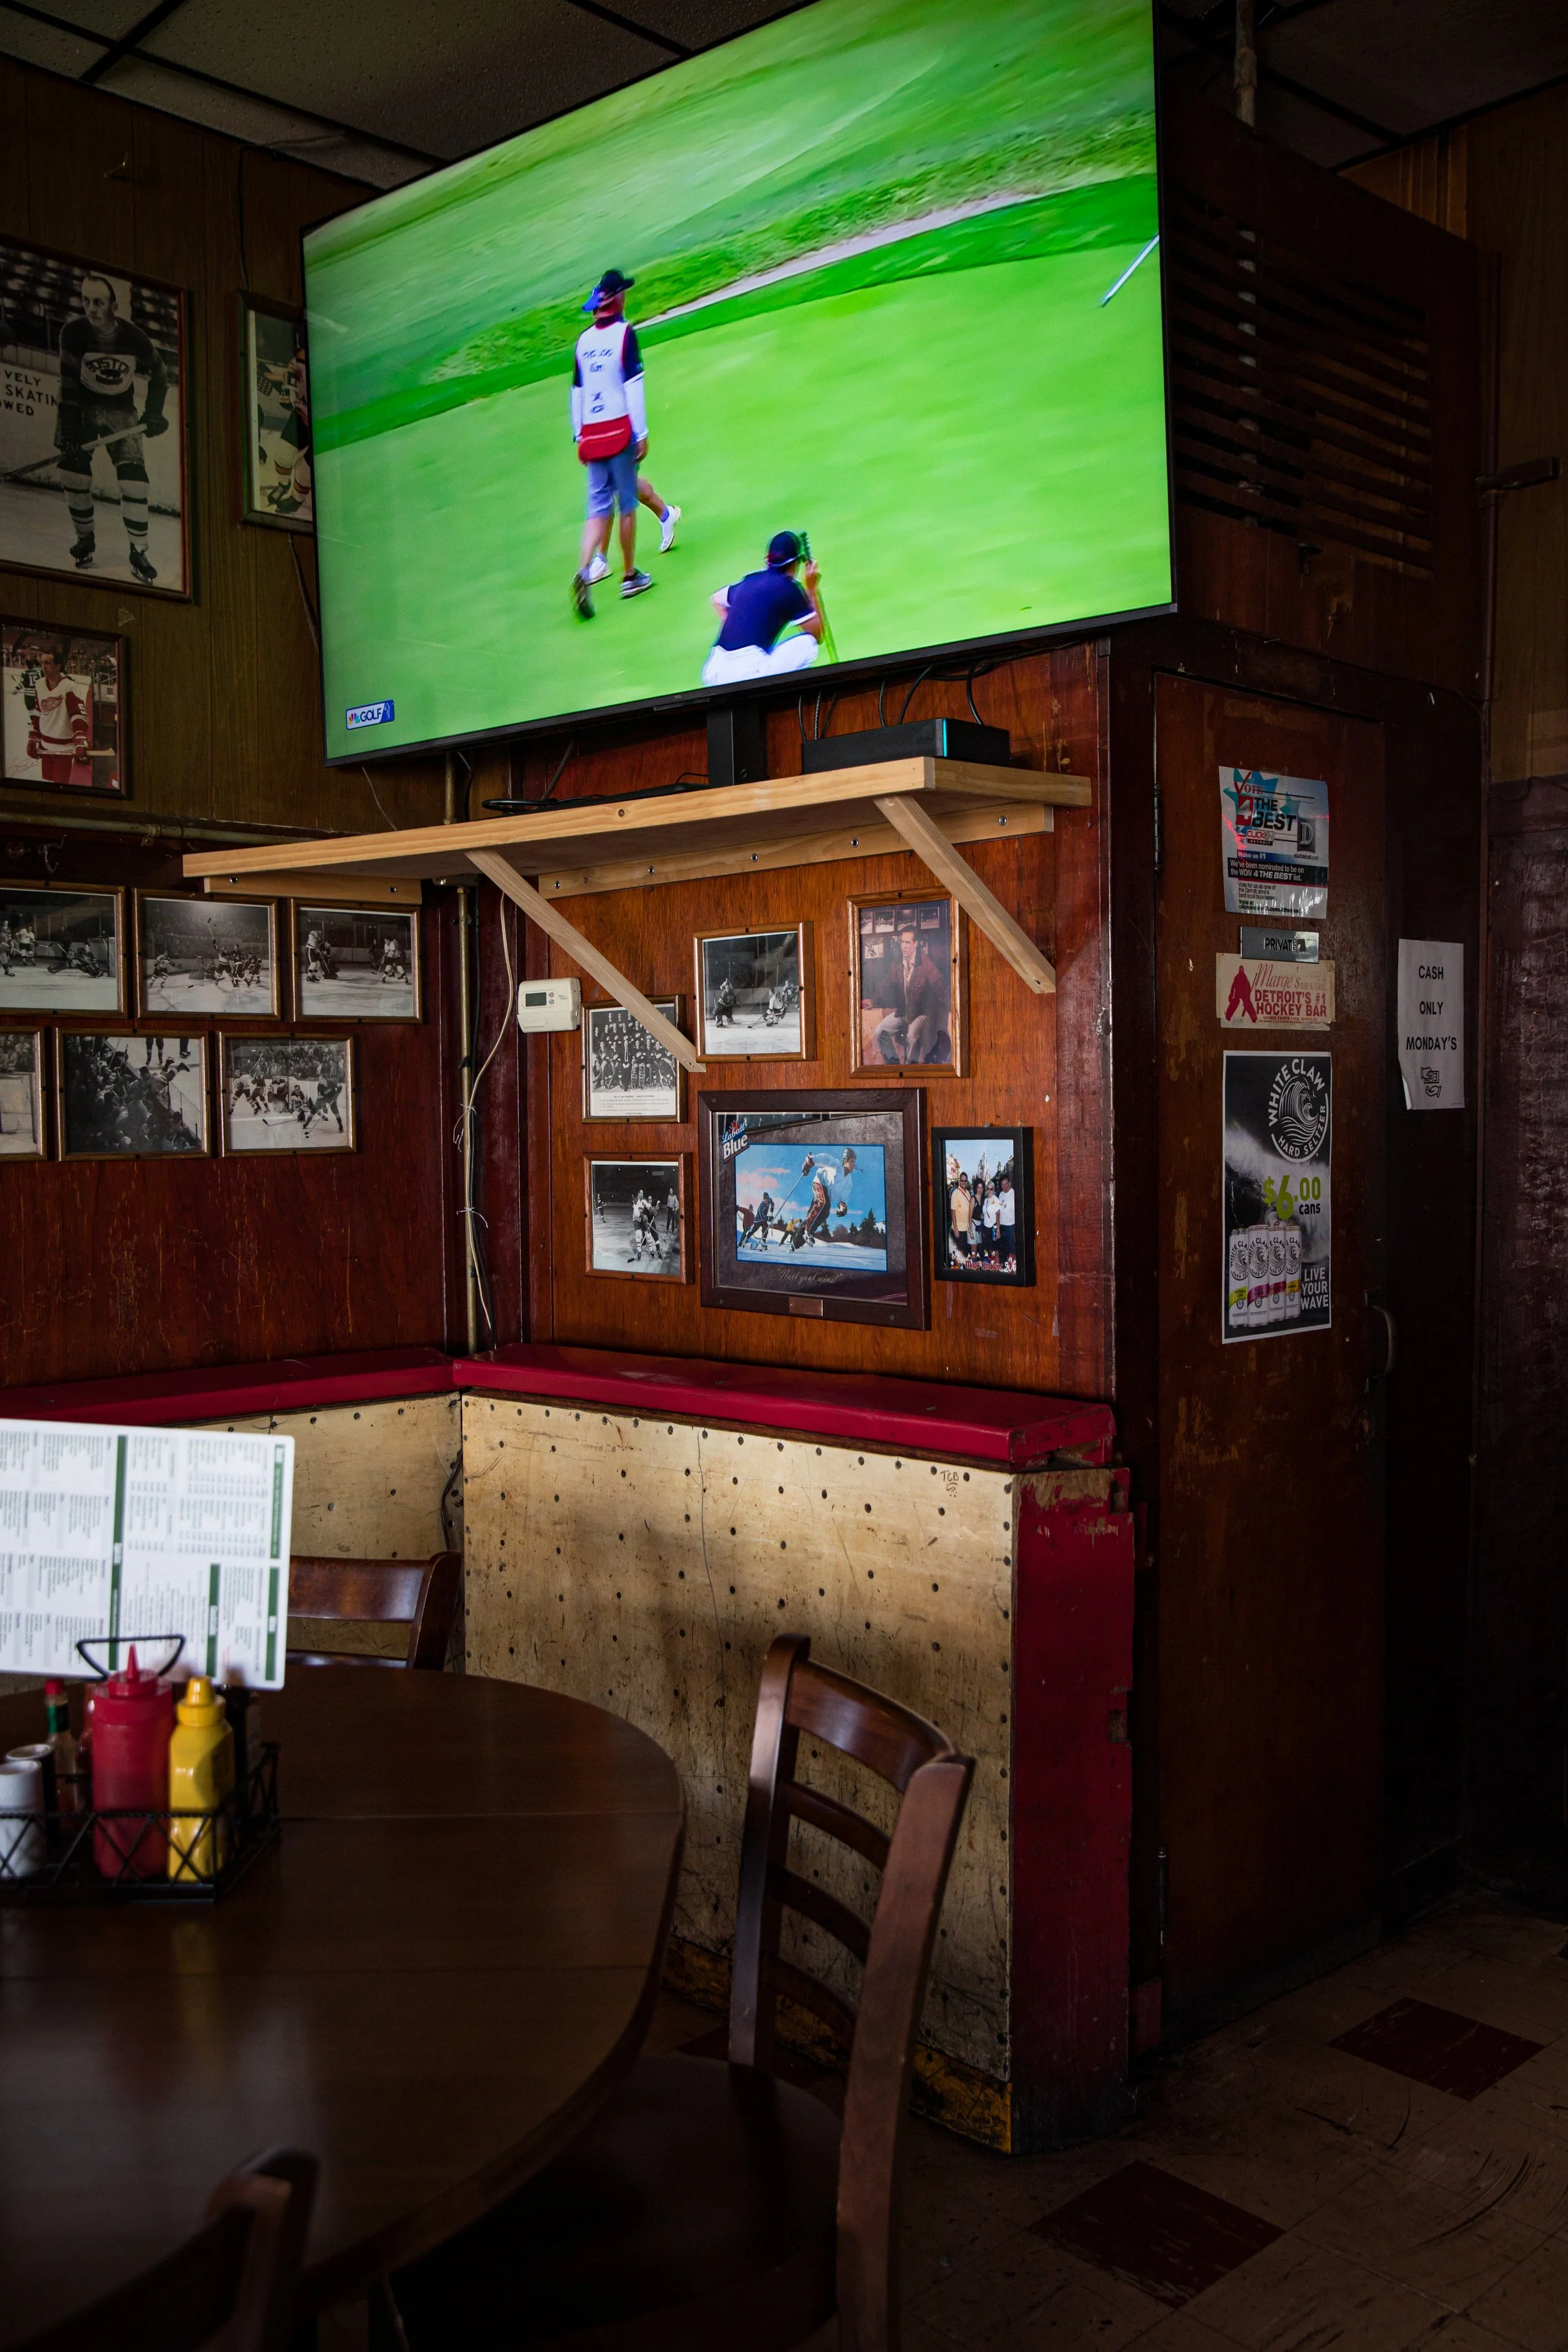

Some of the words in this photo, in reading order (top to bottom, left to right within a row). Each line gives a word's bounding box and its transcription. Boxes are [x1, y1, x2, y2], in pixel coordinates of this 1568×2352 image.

[360, 708, 381, 722] GOLF
[1234, 771, 1263, 795] VOTE
[1237, 799, 1253, 819] 4
[1254, 797, 1278, 811] THE
[1251, 811, 1297, 831] BEST
[1230, 860, 1244, 868] We've
[1246, 861, 1258, 869] been
[1258, 863, 1284, 871] nominated
[1239, 869, 1252, 877] WDIV
[1273, 872, 1293, 881] BEST
[1255, 963, 1300, 991] Marge's
[1419, 965, 1444, 980] CASH
[1254, 990, 1311, 1004] DETROIT'S
[1315, 992, 1326, 1005] #1
[1256, 1002, 1302, 1016] HOCKEY
[1306, 1004, 1327, 1017] BAR
[1419, 1001, 1444, 1015] ONLY
[1406, 1036, 1457, 1051] MONDAY'S
[1268, 1064, 1291, 1126] WHITE
[1291, 1058, 1325, 1091] CLAW
[722, 1121, 746, 1143] Labatt
[1278, 1135, 1300, 1157] HARD
[1304, 1105, 1326, 1155] SELTZER
[723, 1135, 748, 1160] Blue
[1264, 1175, 1321, 1220] $6.00
[1299, 1203, 1321, 1215] cans
[798, 1273, 817, 1285] goal
[1304, 1267, 1326, 1281] LIVE
[1301, 1281, 1328, 1296] YOUR
[1300, 1294, 1328, 1310] WAVE
